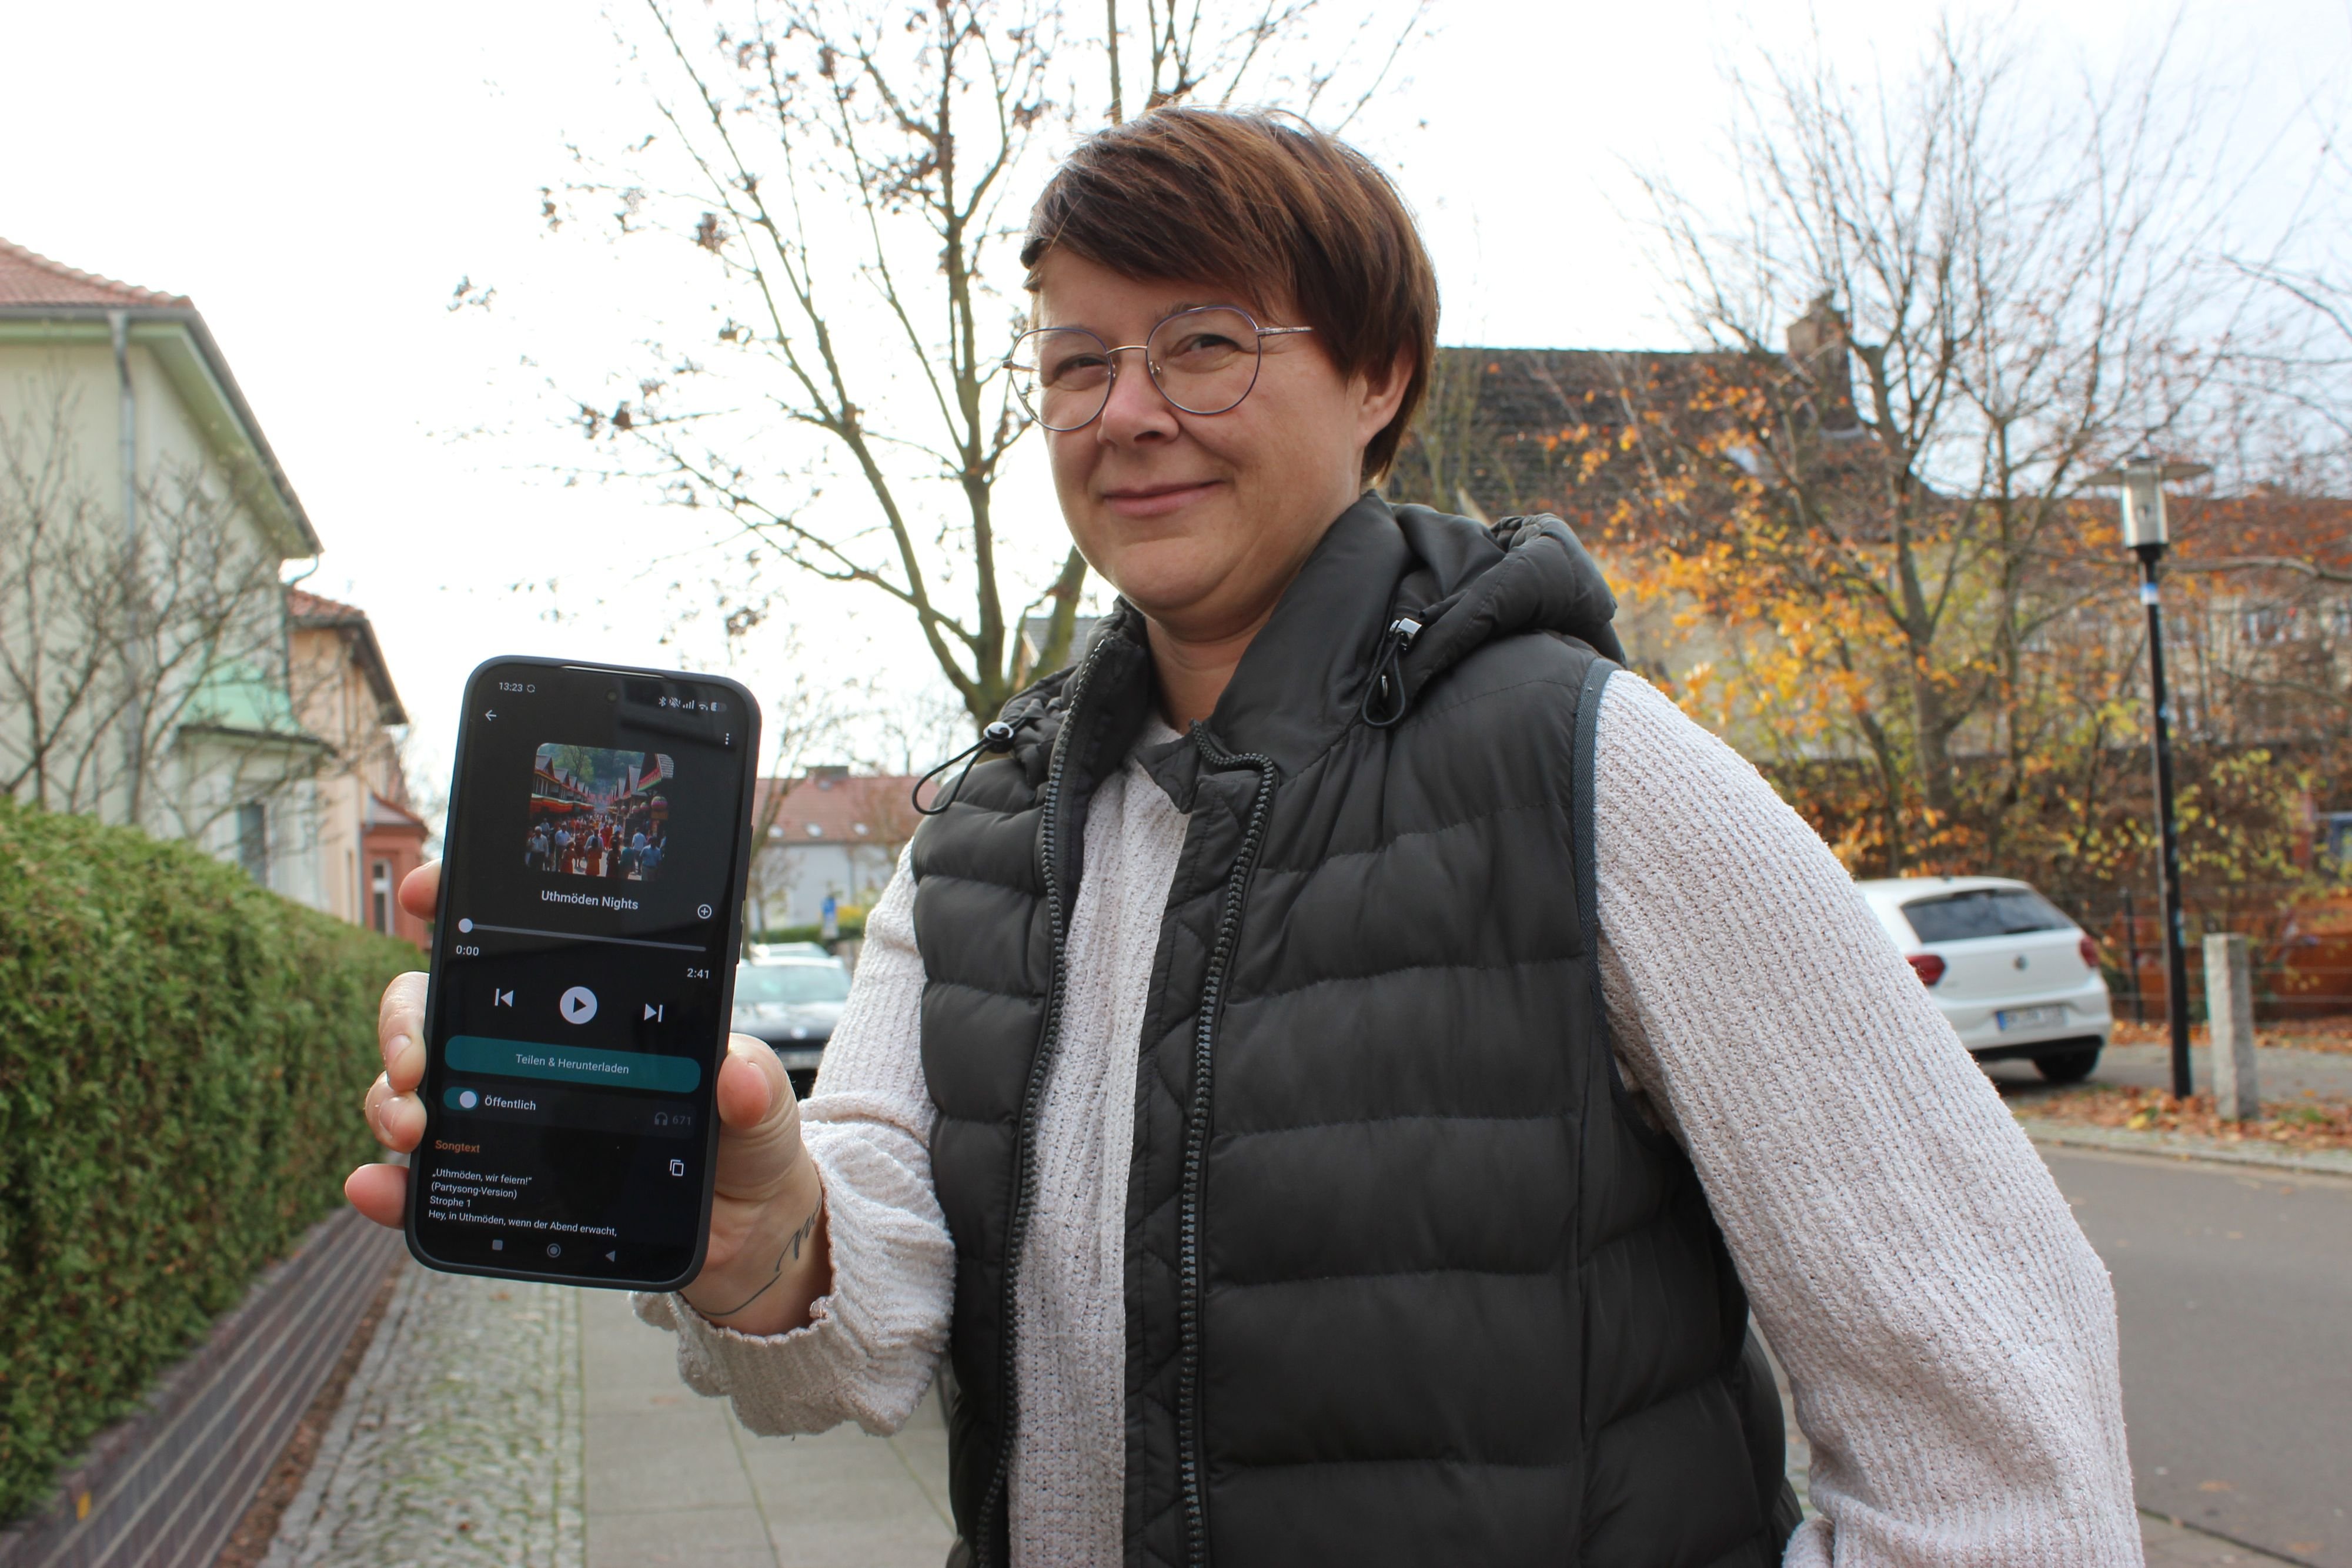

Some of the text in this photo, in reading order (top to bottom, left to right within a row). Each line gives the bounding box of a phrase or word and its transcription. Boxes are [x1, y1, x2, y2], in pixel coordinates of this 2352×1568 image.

[499, 682, 523, 692] 13:23
[541, 890, 639, 910] Uthmöden Nights
[456, 945, 479, 956] 0:00
[687, 968, 709, 979] 2:41
[516, 1054, 629, 1074] Teilen & Herunterladen
[485, 1095, 536, 1110] Öffentlich
[673, 1115, 691, 1125] 671
[435, 1139, 480, 1154] Songtext
[485, 1174, 499, 1182] wir
[431, 1181, 517, 1199] (Partysong-Version)
[430, 1196, 471, 1208] Strophe 1
[429, 1210, 617, 1237] Hey, in Uthmöden, wenn der Abend erwacht,
